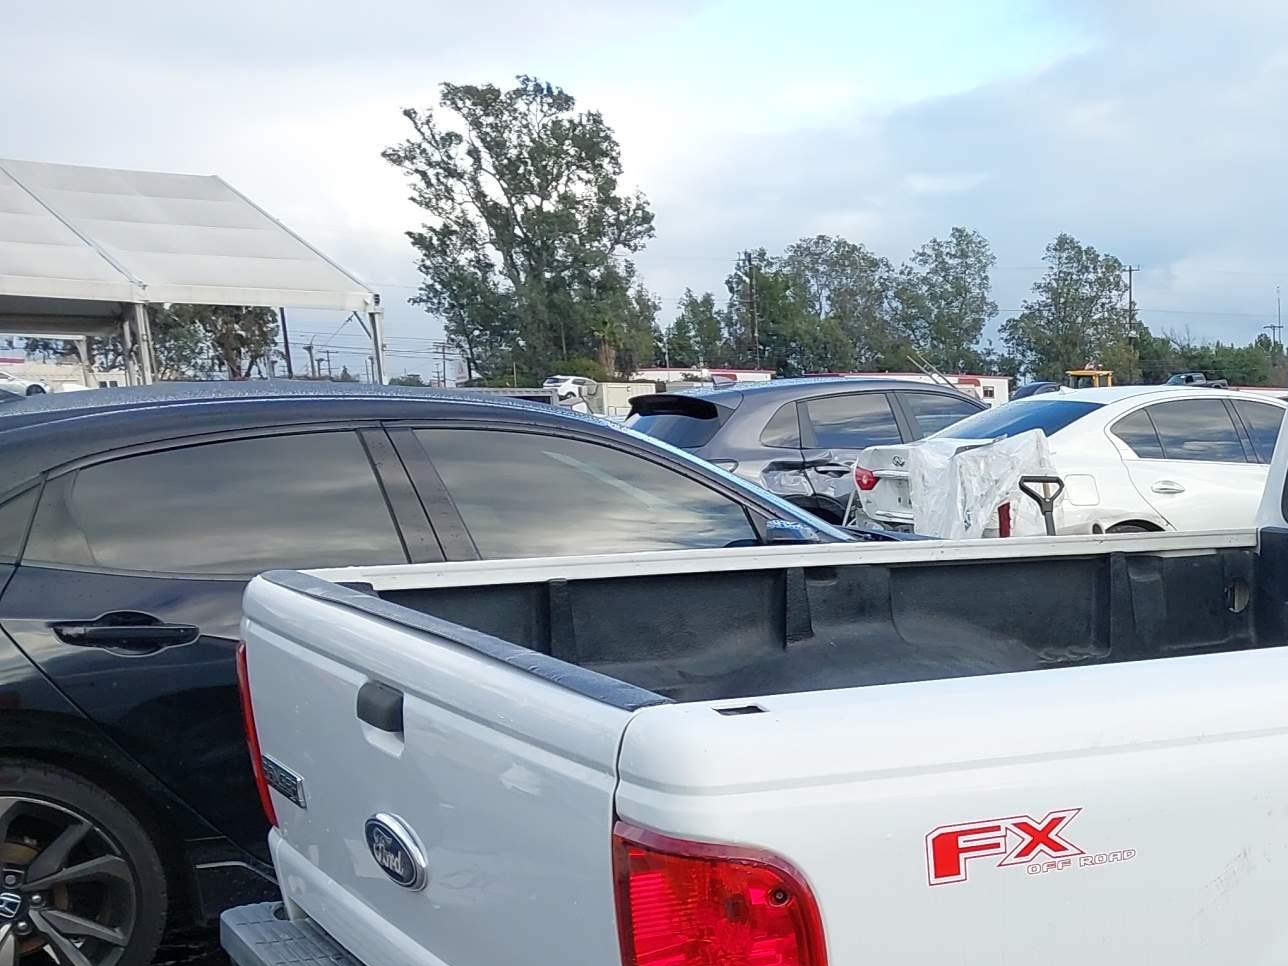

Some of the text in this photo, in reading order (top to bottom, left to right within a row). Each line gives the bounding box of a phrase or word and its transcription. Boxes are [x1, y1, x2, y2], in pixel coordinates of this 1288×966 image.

[373, 827, 404, 876] Ford
[925, 807, 1085, 886] FX
[1026, 848, 1137, 876] OFF ROAD
